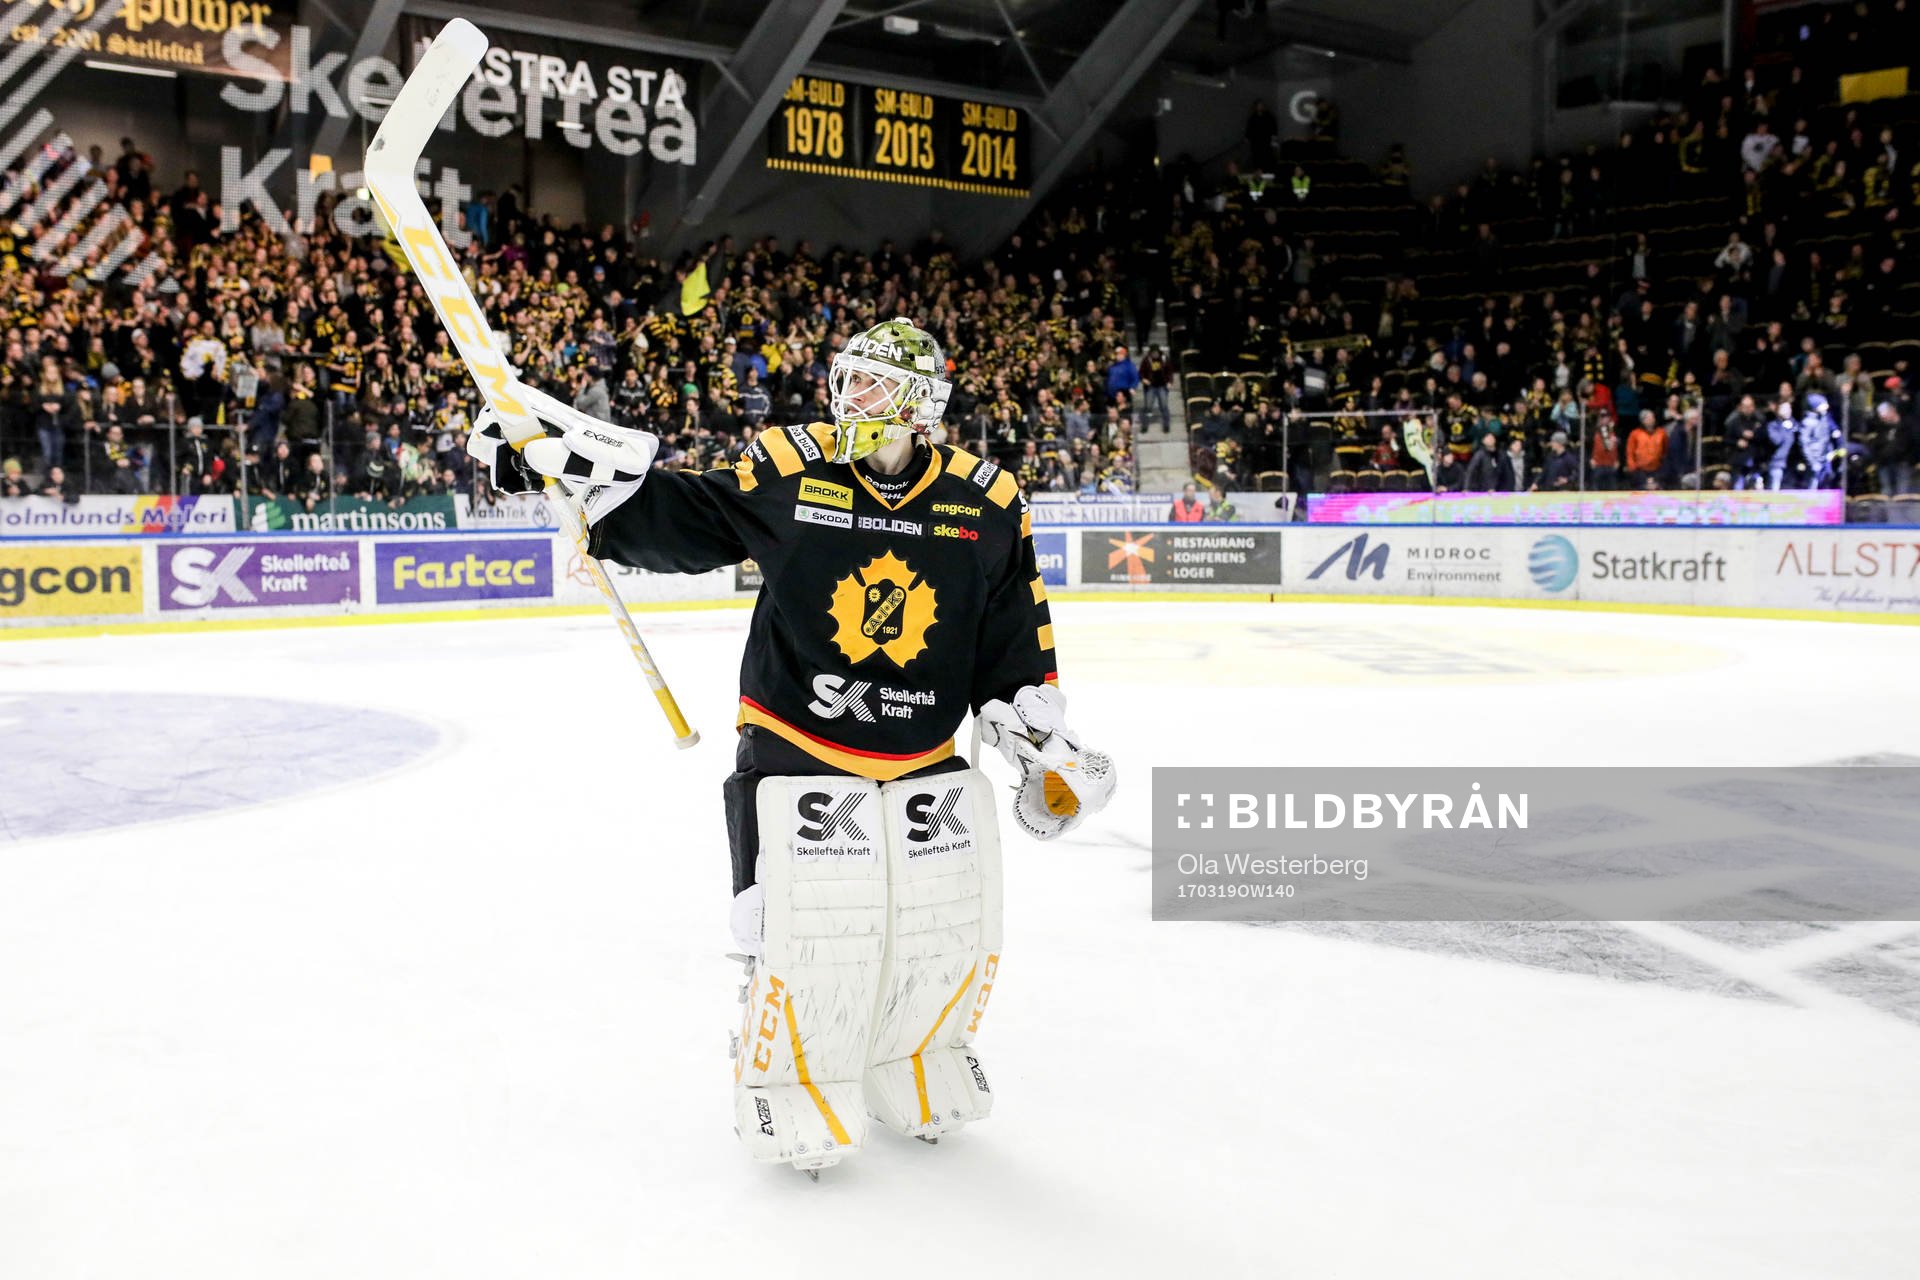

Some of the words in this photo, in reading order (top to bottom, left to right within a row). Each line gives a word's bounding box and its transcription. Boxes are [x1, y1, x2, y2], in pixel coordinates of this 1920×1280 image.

[473, 47, 598, 98] STRA
[219, 22, 697, 165] Skeefteå
[875, 88, 933, 119] SM-GULD
[784, 106, 844, 159] 1978
[875, 118, 935, 169] 2013
[961, 131, 1016, 180] 2014
[804, 484, 848, 501] BROKK
[0, 508, 135, 526] olmlunds
[291, 506, 446, 531] martinsons
[932, 503, 980, 517] engcon
[862, 516, 922, 535] BOLIDEN
[934, 525, 979, 541] skebo
[1174, 537, 1255, 549] RESTAURANG
[1174, 552, 1246, 564] KONFERENS
[1407, 548, 1491, 560] MIDROC
[261, 555, 350, 573] Skellefteå
[1592, 551, 1726, 582] Statkraft
[261, 576, 307, 592] Kraft
[1407, 569, 1501, 583] Environment
[882, 626, 898, 635] 1921
[879, 687, 935, 705] Skellefteå
[881, 703, 912, 719] Kraft
[797, 847, 843, 856] Skellefteå
[847, 847, 871, 856] Kraft
[908, 845, 950, 859] Skellefteå
[951, 839, 971, 851] Kraft
[967, 953, 999, 1033] CCM
[753, 975, 784, 1072] CCM
